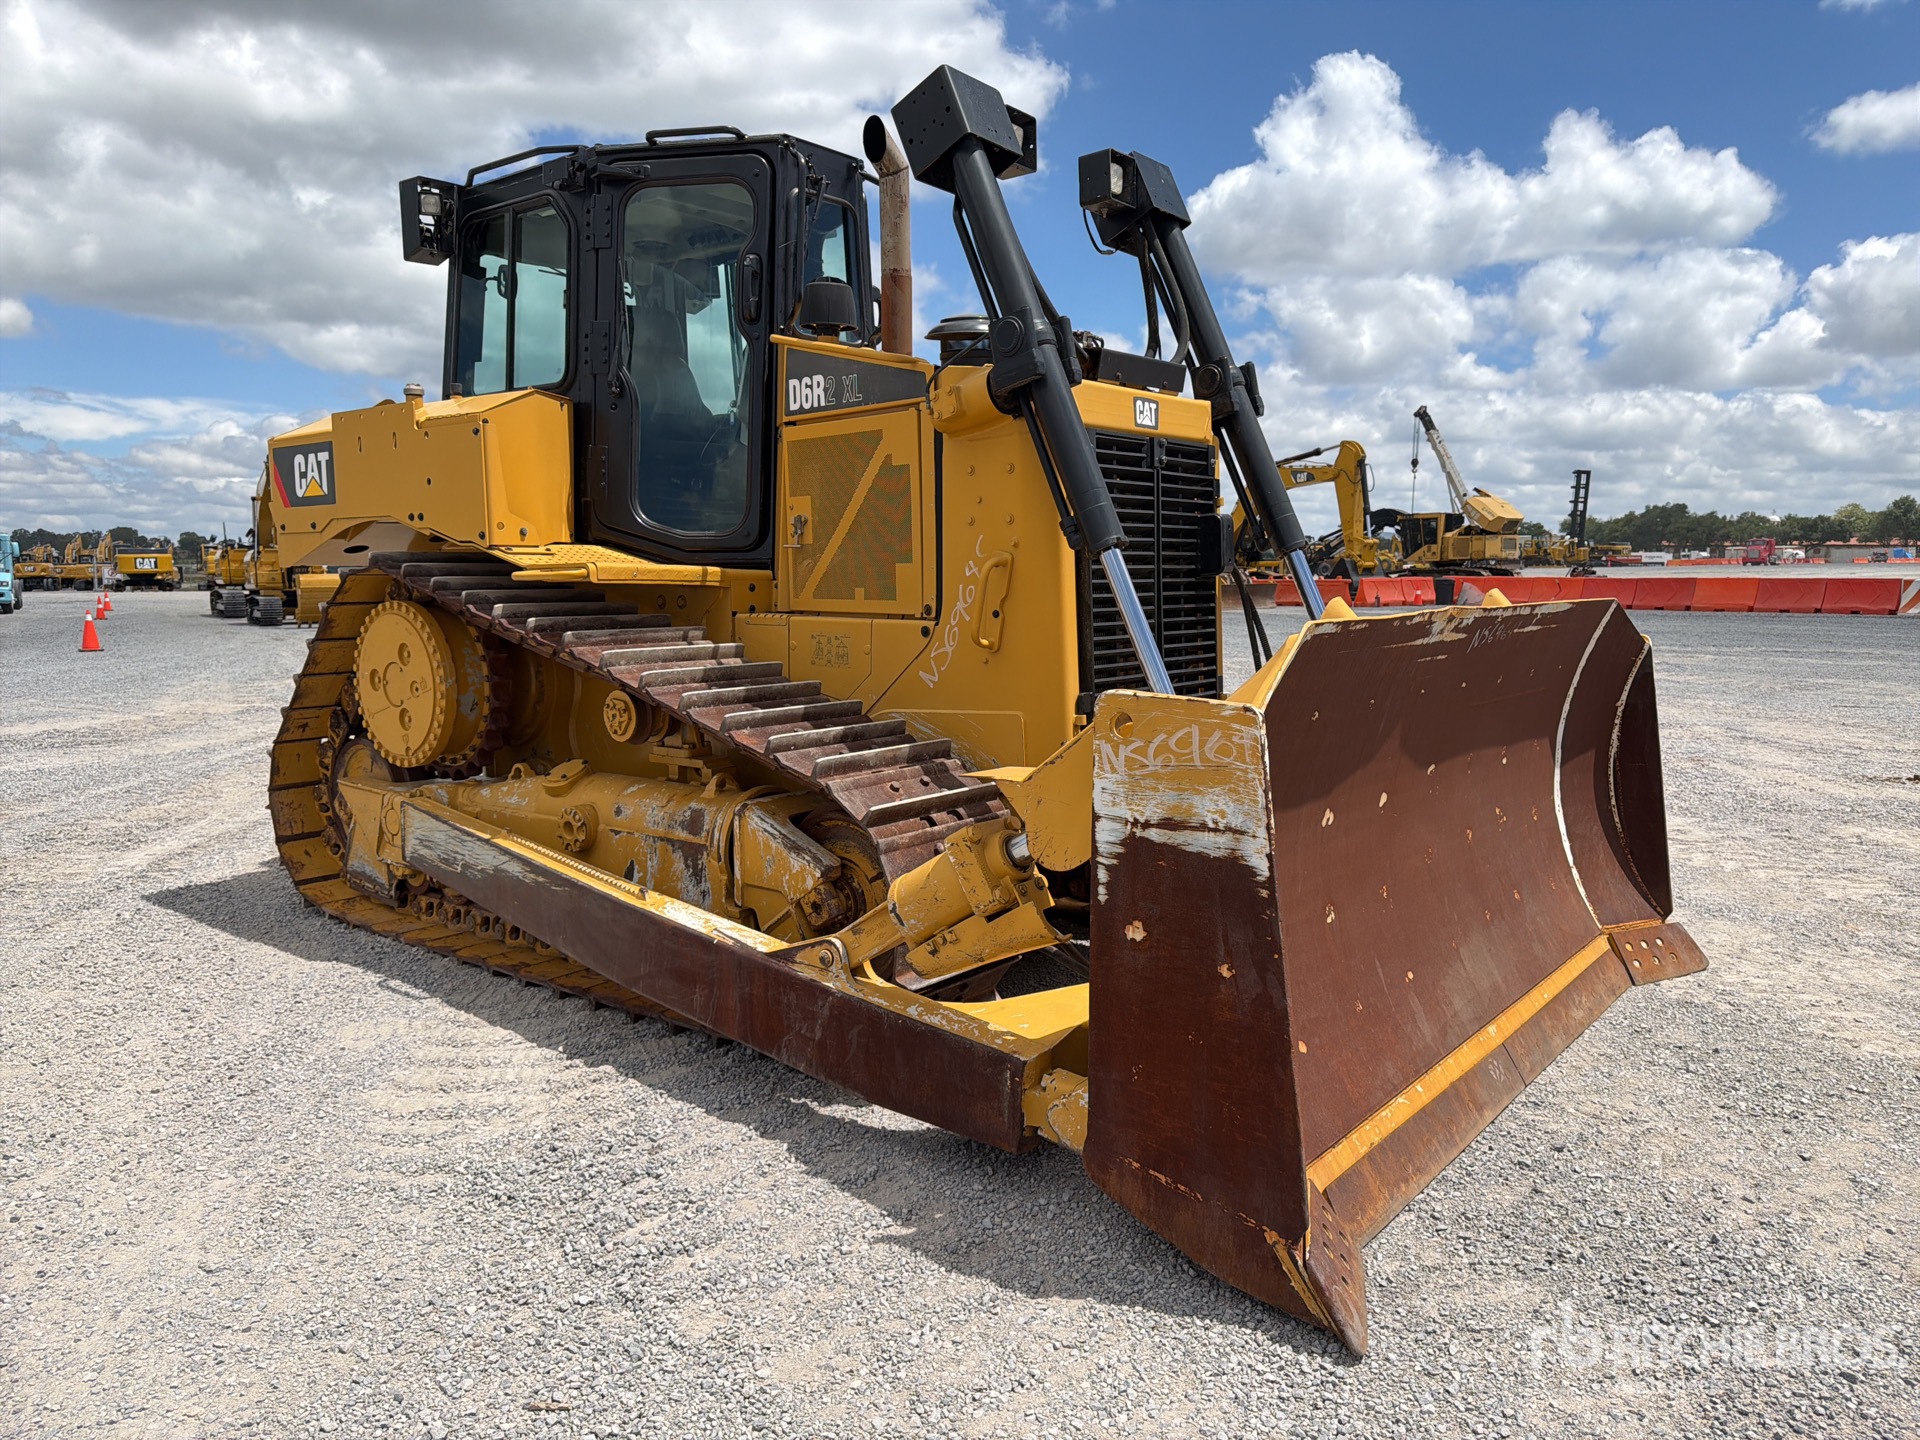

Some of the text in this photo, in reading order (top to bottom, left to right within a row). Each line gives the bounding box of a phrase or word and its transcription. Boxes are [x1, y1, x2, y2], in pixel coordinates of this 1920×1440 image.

[842, 374, 863, 403] XL
[1135, 399, 1157, 427] CAT
[293, 451, 330, 498] CAT
[1296, 471, 1308, 483] CAT
[135, 557, 156, 569] CAT
